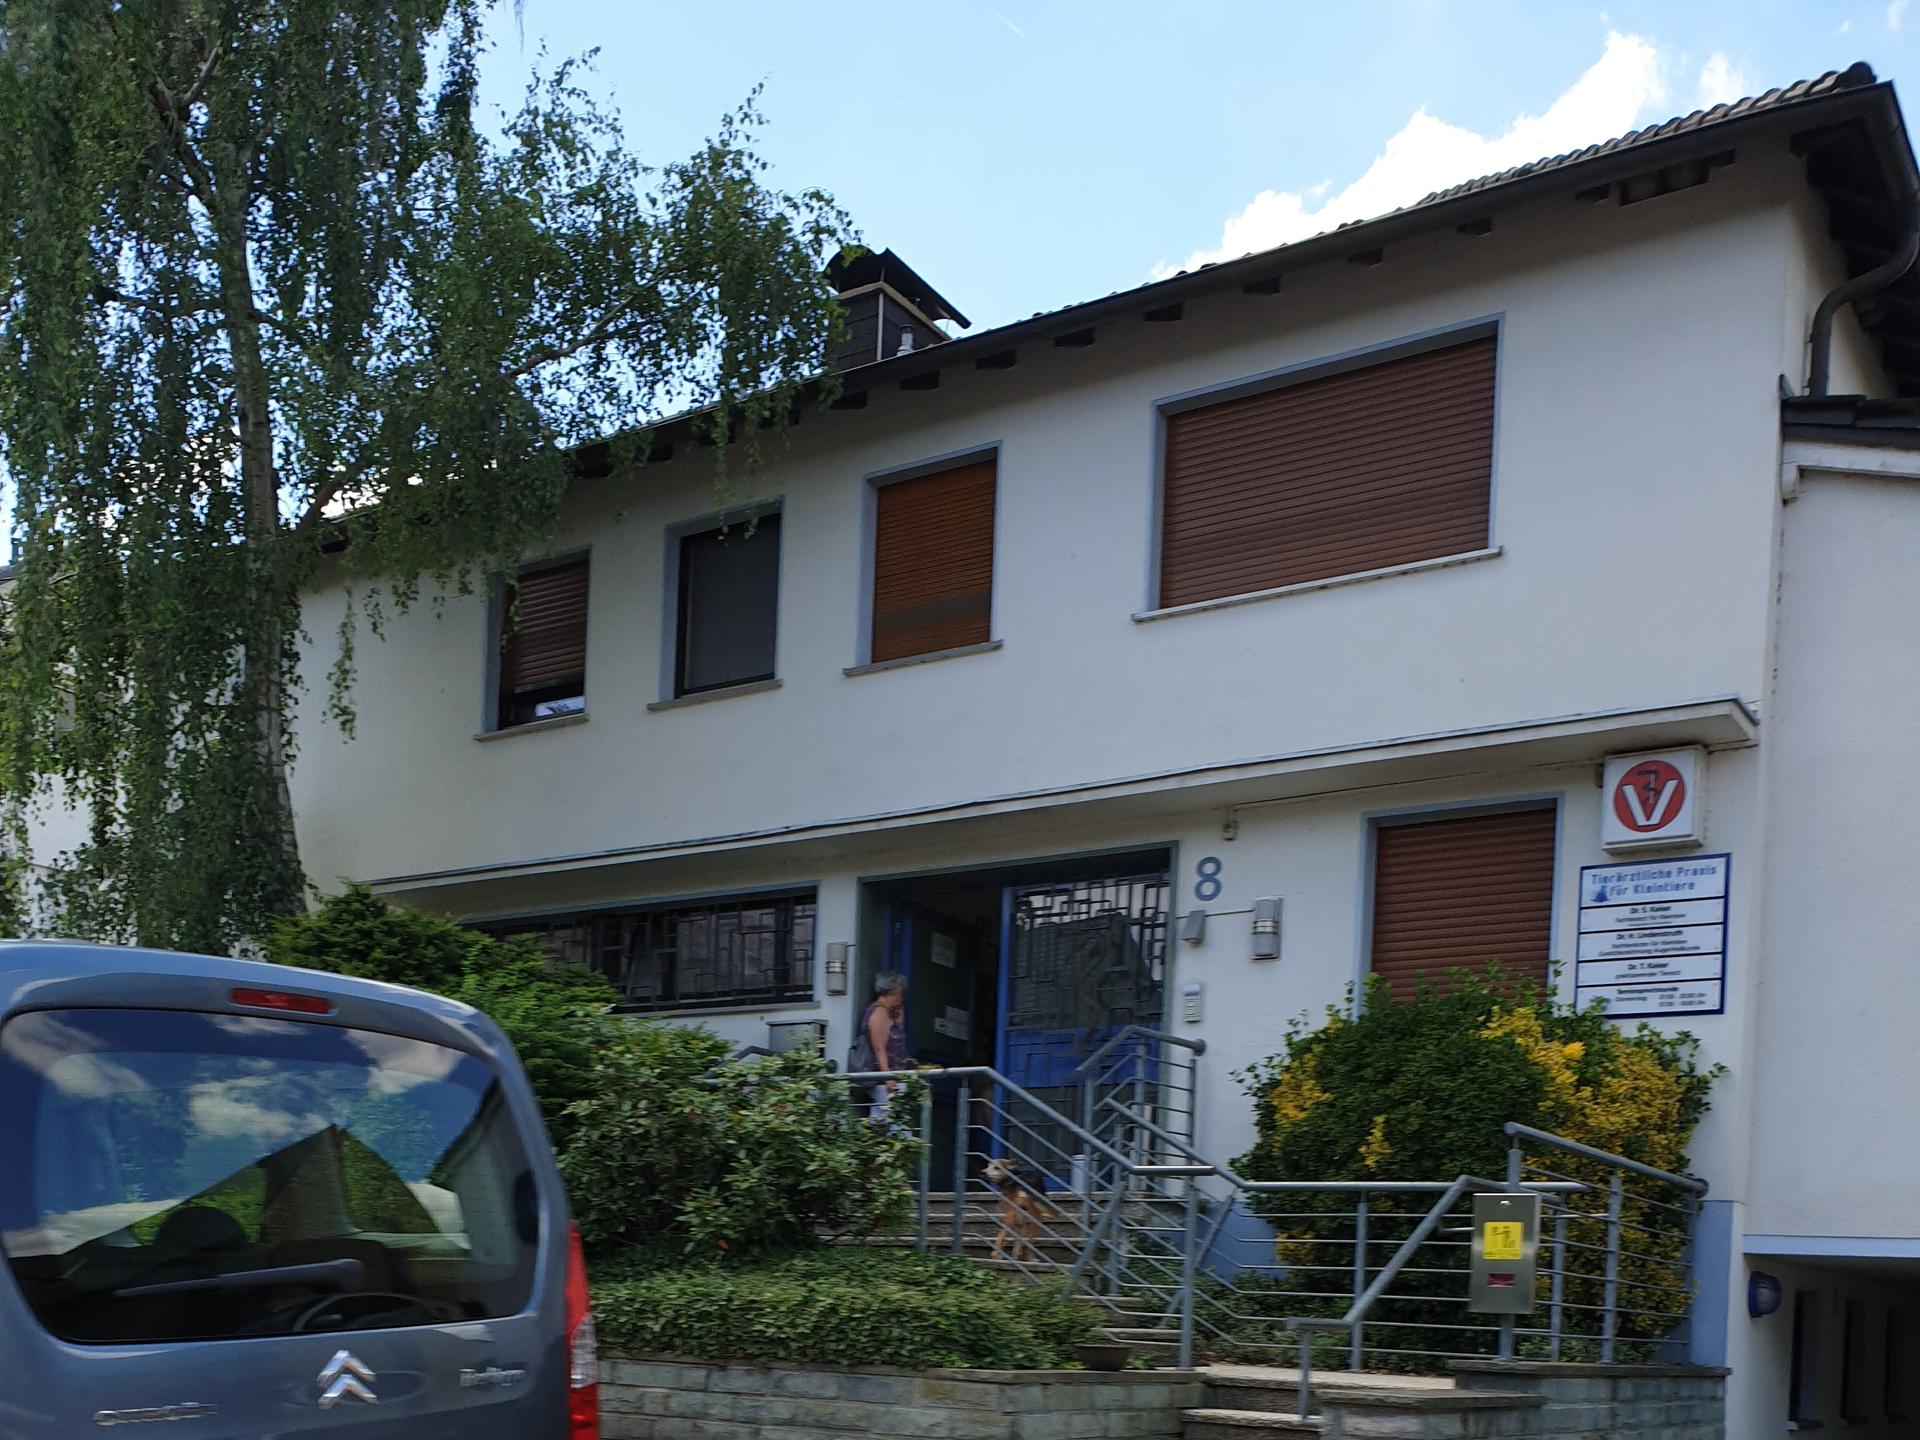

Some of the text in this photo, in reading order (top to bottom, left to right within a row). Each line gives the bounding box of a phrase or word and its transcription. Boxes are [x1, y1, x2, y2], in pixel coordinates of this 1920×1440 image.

[1194, 856, 1222, 901] 8
[1591, 865, 1717, 885] Tierärztliche Praxis
[1633, 881, 1696, 894] Kleintiere
